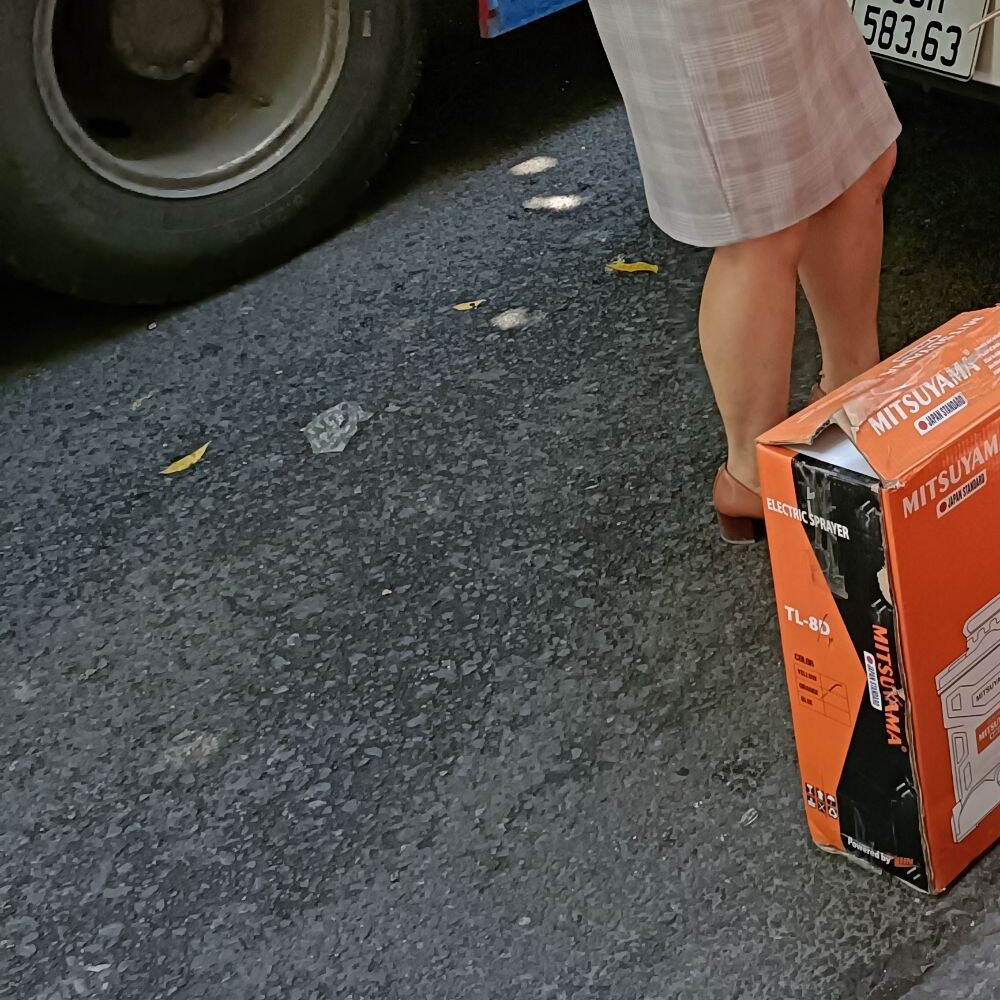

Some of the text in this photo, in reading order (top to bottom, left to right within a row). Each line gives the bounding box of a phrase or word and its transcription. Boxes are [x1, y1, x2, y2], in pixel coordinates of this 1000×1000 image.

[862, 4, 962, 67] 583.63
[867, 355, 982, 437] MITSUYAMA
[766, 497, 850, 540] ELECTRIC SPRAYER
[872, 624, 903, 745] MITSUYAMA
[847, 836, 880, 860] Powered
[880, 852, 892, 865] by
